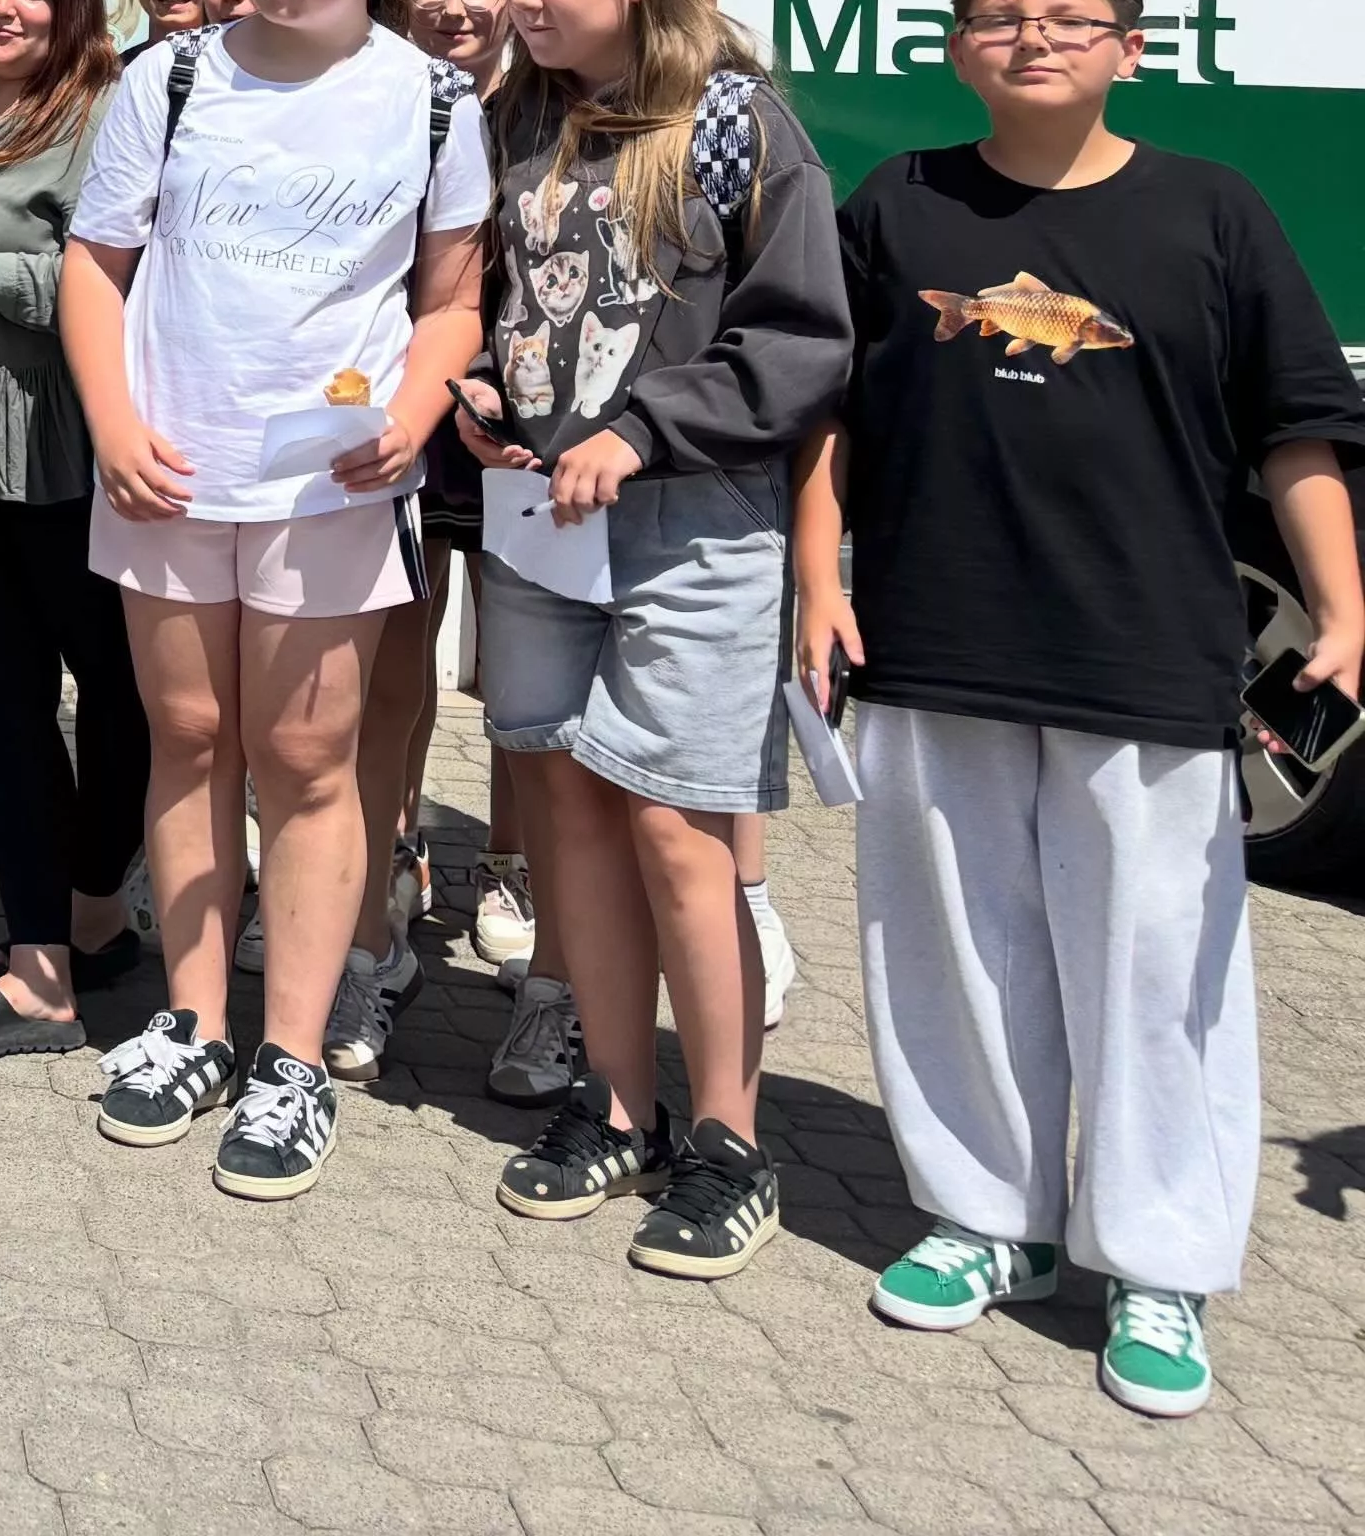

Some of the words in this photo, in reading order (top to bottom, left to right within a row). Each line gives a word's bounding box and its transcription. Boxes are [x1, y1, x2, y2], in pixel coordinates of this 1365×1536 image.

[158, 165, 269, 238] New
[273, 165, 401, 255] York
[190, 240, 304, 273] NOWHERE
[994, 367, 1019, 381] blub
[1020, 370, 1045, 385] blub
